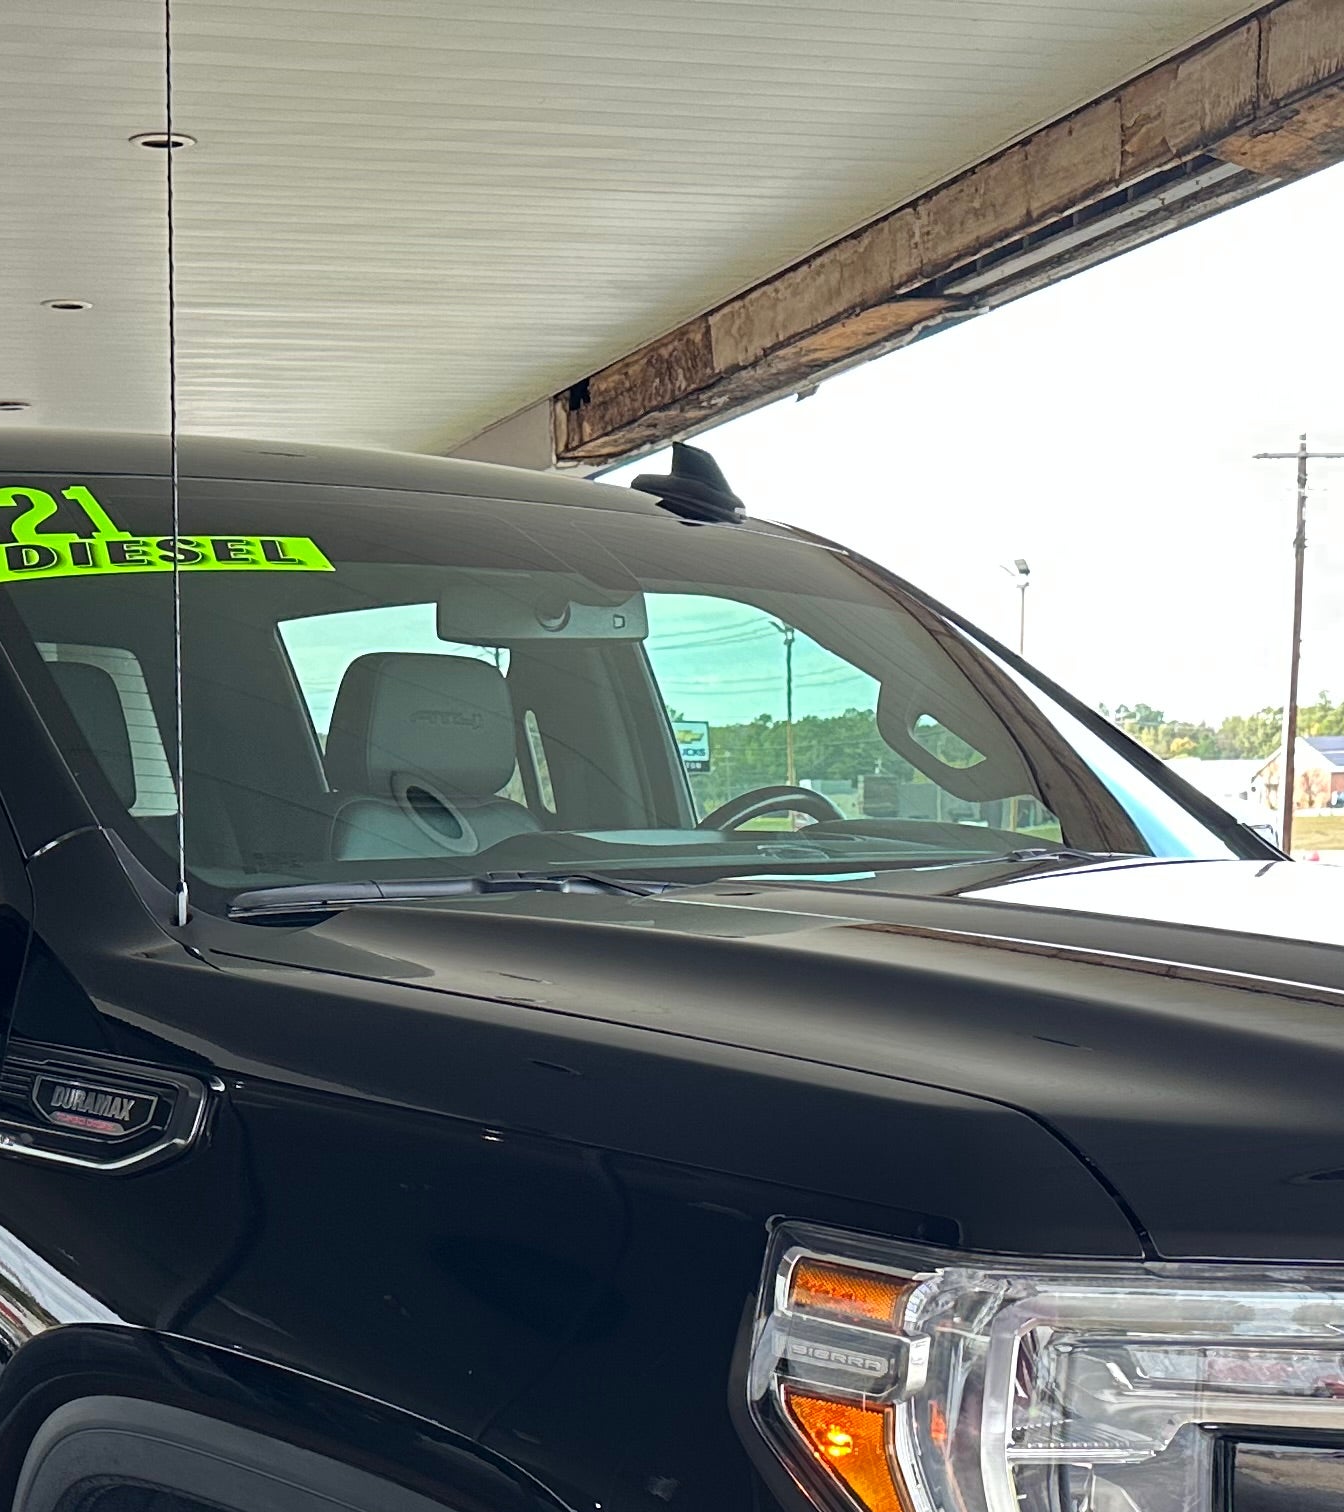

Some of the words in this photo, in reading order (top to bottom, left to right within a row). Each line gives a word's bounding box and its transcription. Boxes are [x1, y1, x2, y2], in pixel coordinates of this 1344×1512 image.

[5, 538, 300, 572] DIESEL
[51, 1085, 136, 1121] DURAMAX
[791, 1343, 882, 1371] SIERRA
